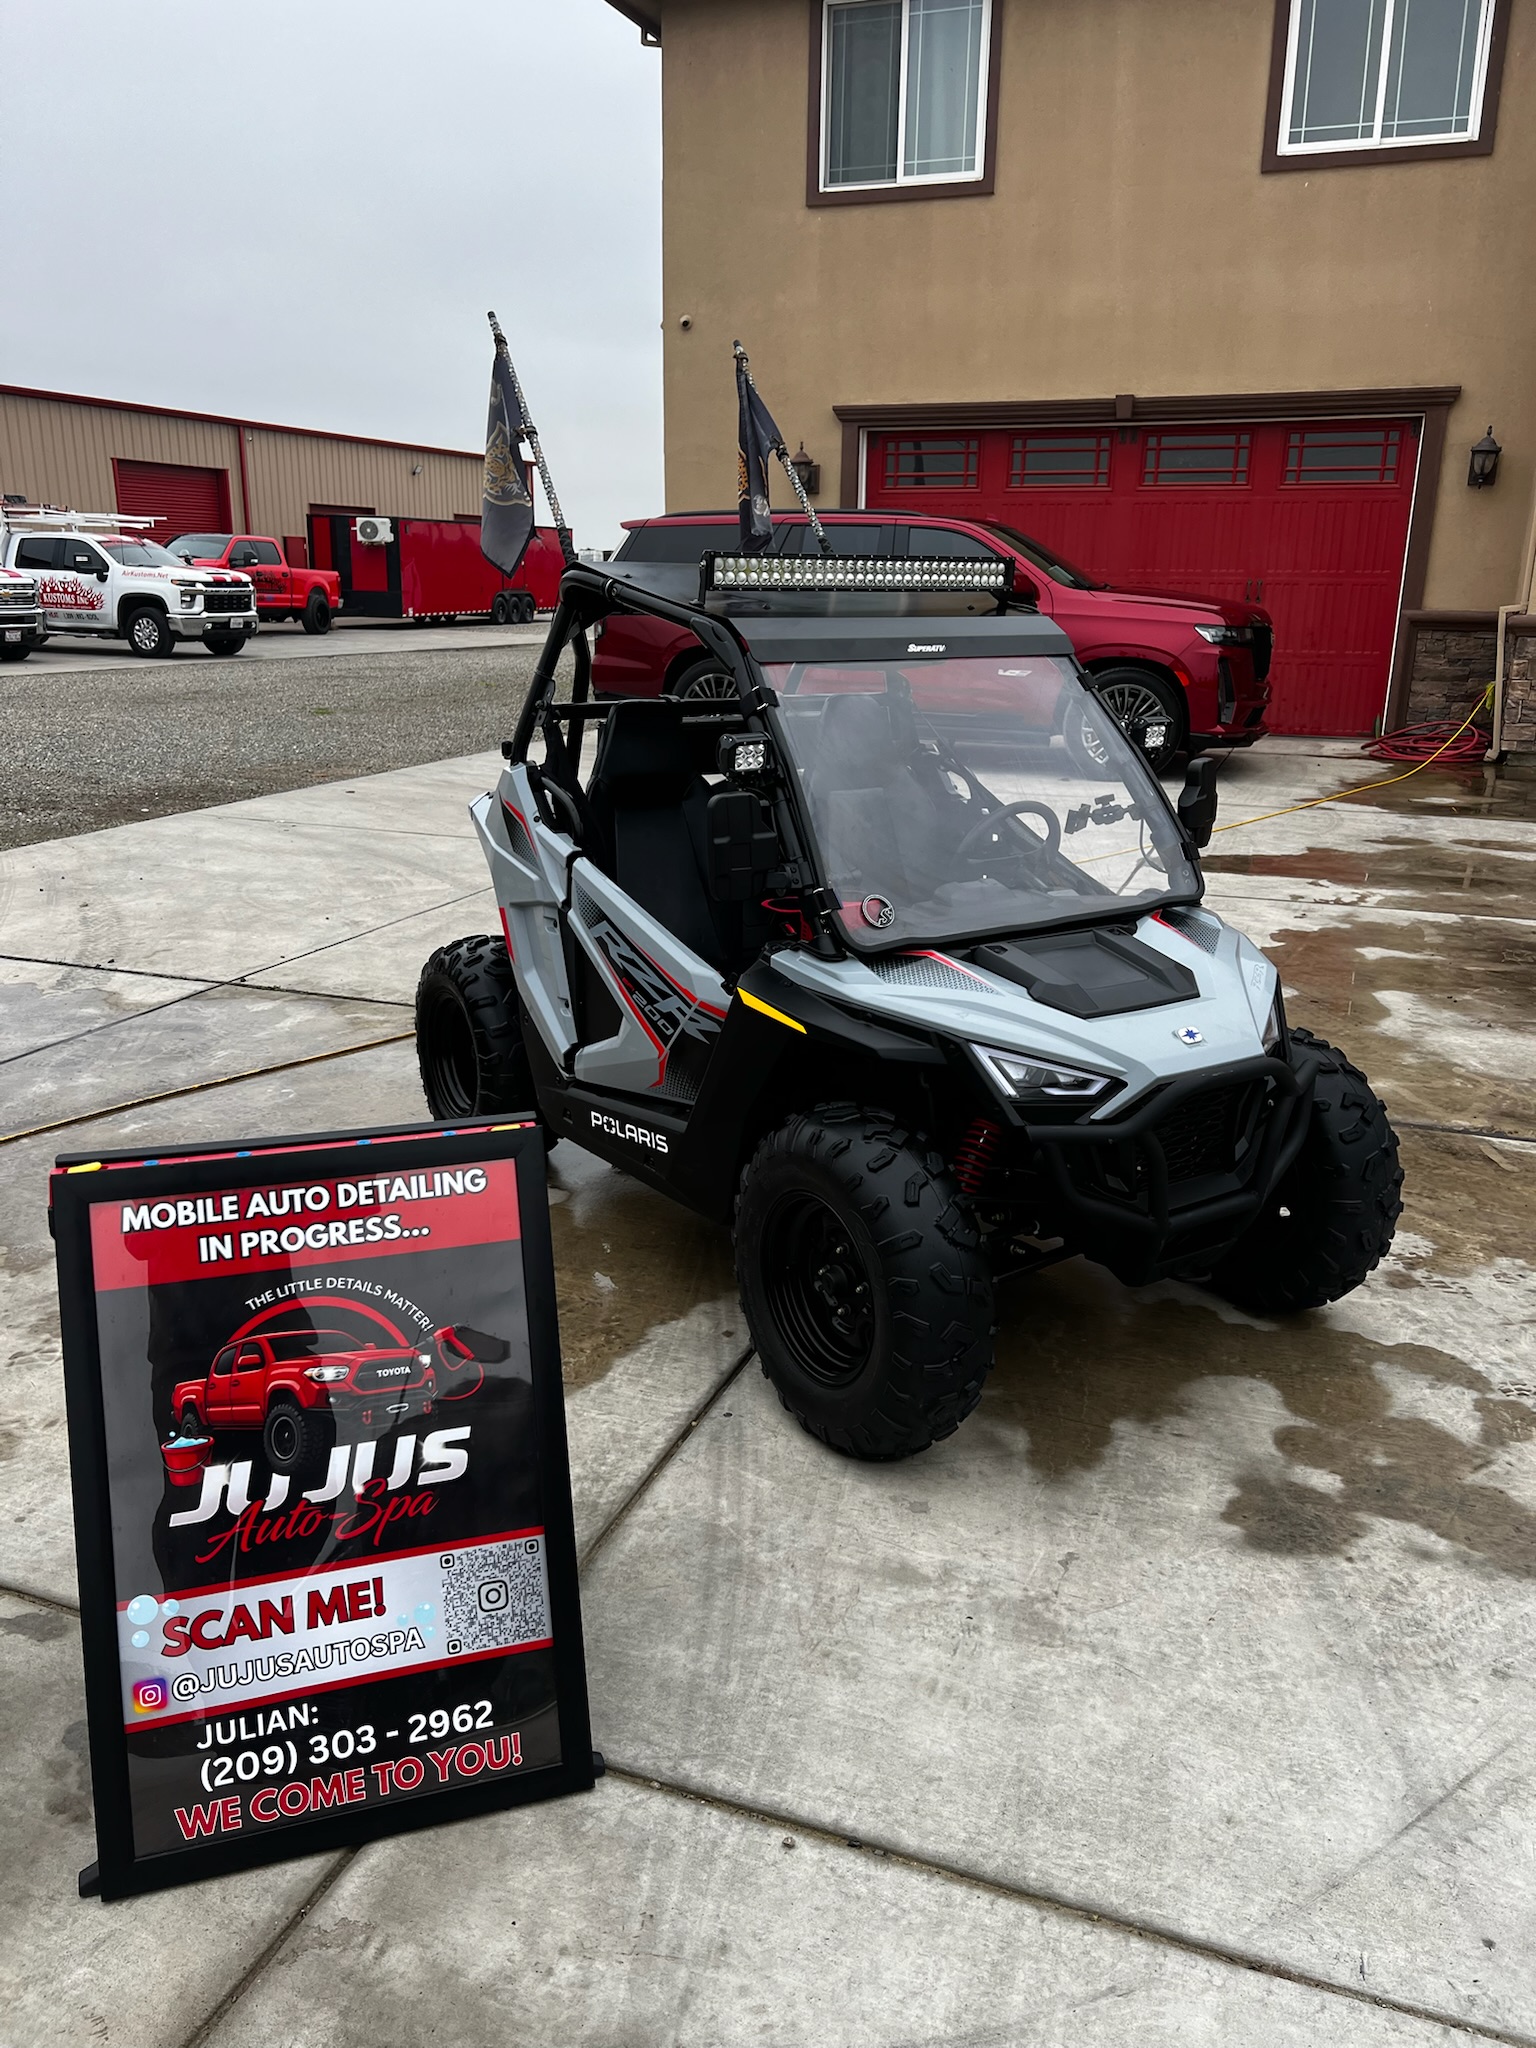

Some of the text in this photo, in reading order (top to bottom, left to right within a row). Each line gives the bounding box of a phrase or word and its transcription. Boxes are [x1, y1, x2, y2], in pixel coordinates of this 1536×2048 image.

[43, 592, 76, 604] KUSTOMS
[77, 595, 90, 605] INC
[589, 920, 721, 1045] RZR
[632, 990, 674, 1036] 200
[590, 1110, 669, 1154] POLARIS
[121, 1168, 488, 1233] MOBILE AUTO DETAILING
[199, 1214, 431, 1263] IN PROGRESS...
[245, 1277, 435, 1332] THE LITTLE DETAILS MATTER!
[376, 1365, 411, 1378] TOYOTA
[161, 1576, 387, 1658] SCAN ME!
[172, 1627, 426, 1701] @JUJUSAUTOSPA
[197, 1703, 320, 1749] JULIAN:
[201, 1741, 298, 1792] (209)
[308, 1725, 377, 1764] 303
[408, 1700, 494, 1743] 2962
[174, 1732, 523, 1841] WE COME TO YOU!
